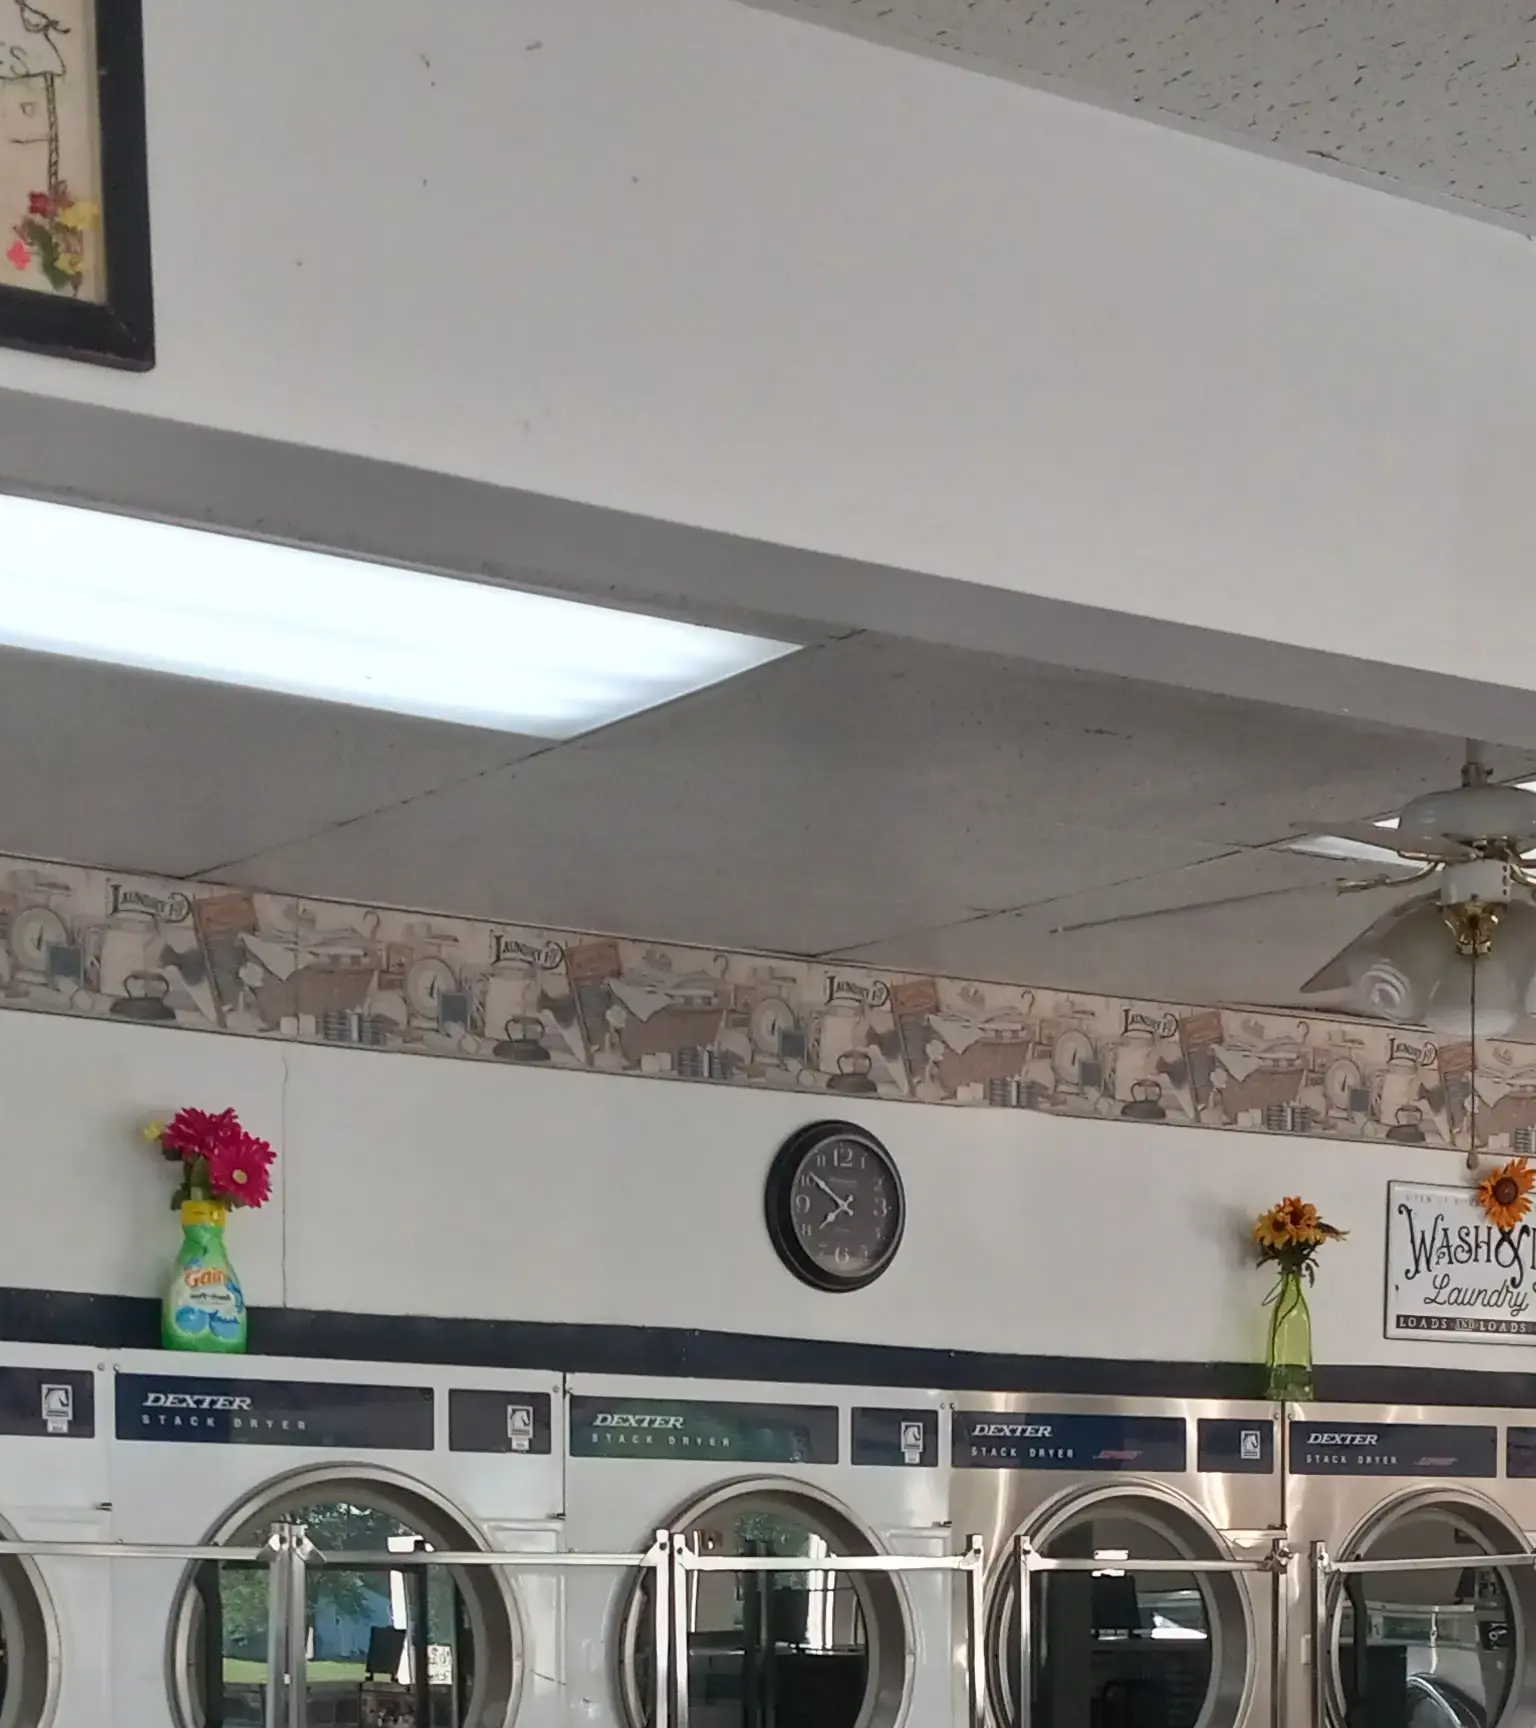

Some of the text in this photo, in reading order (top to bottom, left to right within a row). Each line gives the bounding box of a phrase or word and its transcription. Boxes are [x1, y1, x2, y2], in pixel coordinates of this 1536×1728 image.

[833, 1148, 853, 1167] 12
[795, 1194, 888, 1217] 9 3
[1398, 1203, 1492, 1280] WASH
[834, 1247, 850, 1263] 6
[1424, 1273, 1530, 1317] Laundry
[1399, 1316, 1447, 1329] LOADS
[1480, 1318, 1526, 1333] LOADS
[142, 1392, 253, 1411] DEXTER
[141, 1414, 306, 1431] STACK DRYER
[593, 1413, 685, 1429] DEXTER
[971, 1424, 1053, 1437] DEXTER
[591, 1433, 730, 1448] STACK DRYER
[1307, 1433, 1378, 1446] DEXTER
[971, 1447, 1074, 1459] STACK DRYER
[1307, 1454, 1397, 1465] STACK DRYER
